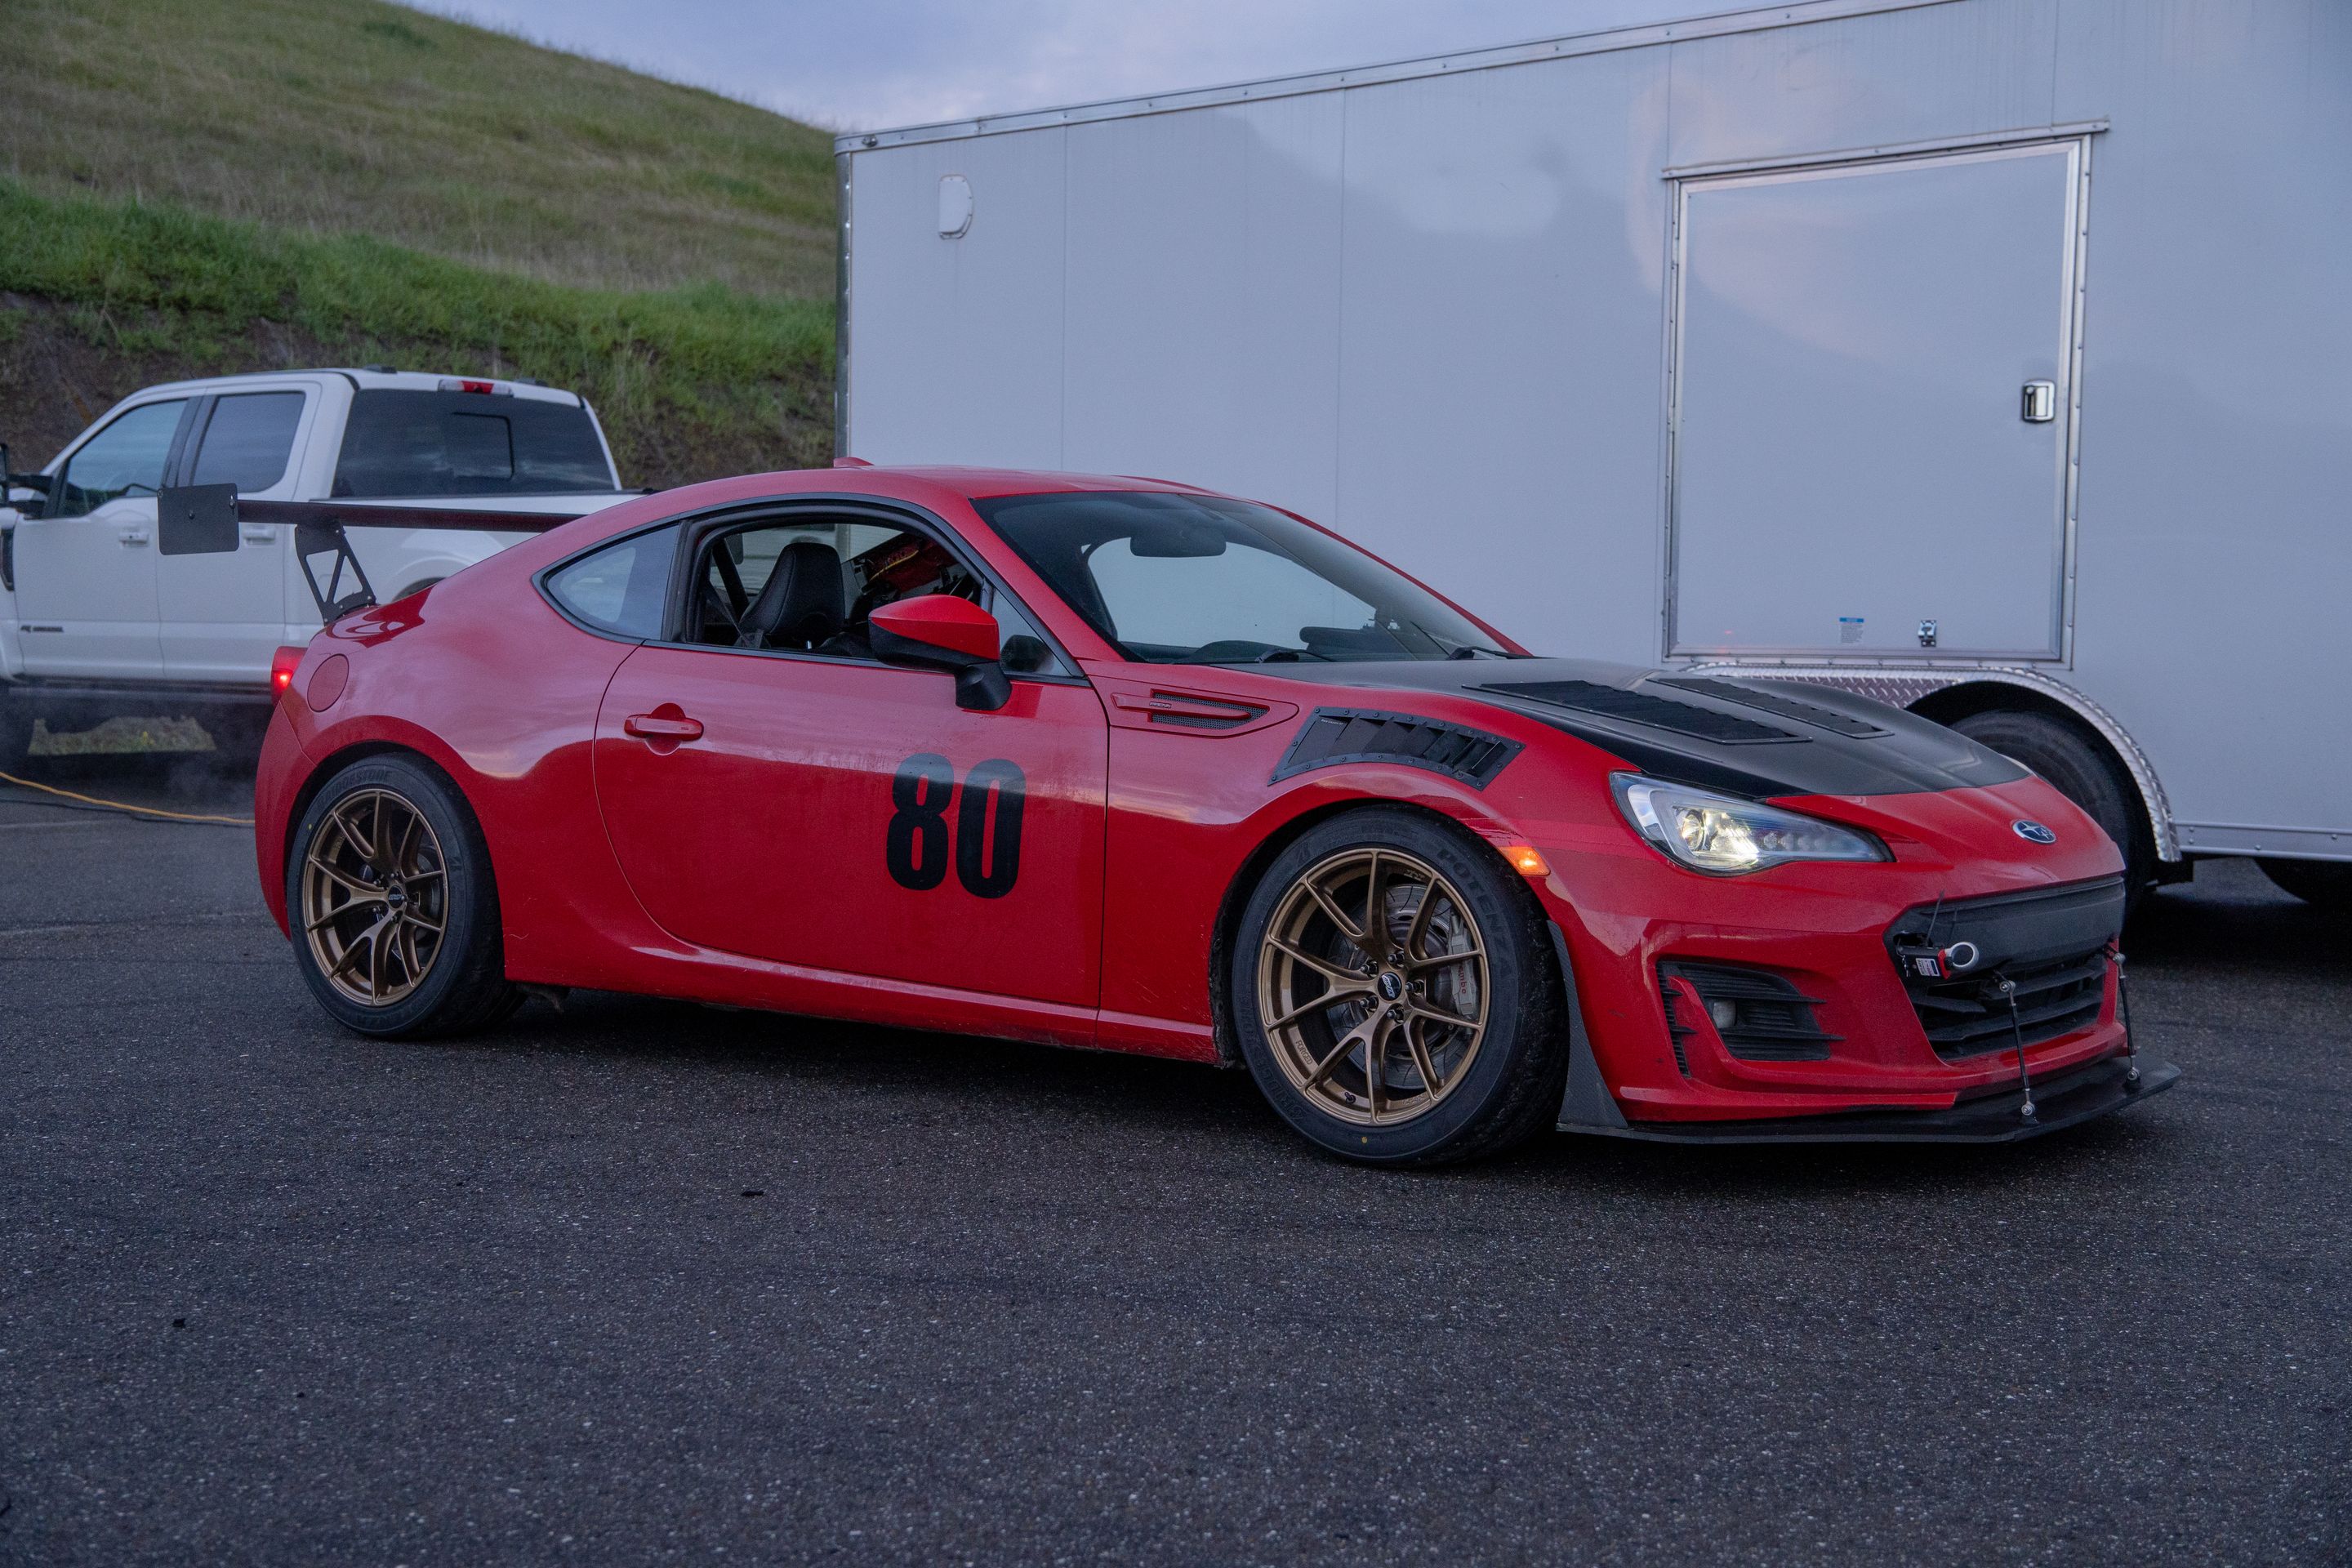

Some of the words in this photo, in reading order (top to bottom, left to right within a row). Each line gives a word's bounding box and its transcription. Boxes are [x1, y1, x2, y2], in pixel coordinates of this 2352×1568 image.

[886, 752, 1027, 899] 80
[1436, 846, 1511, 979] POTENZA
[1458, 966, 1467, 994] embo
[1295, 1040, 1313, 1065] FORGED
